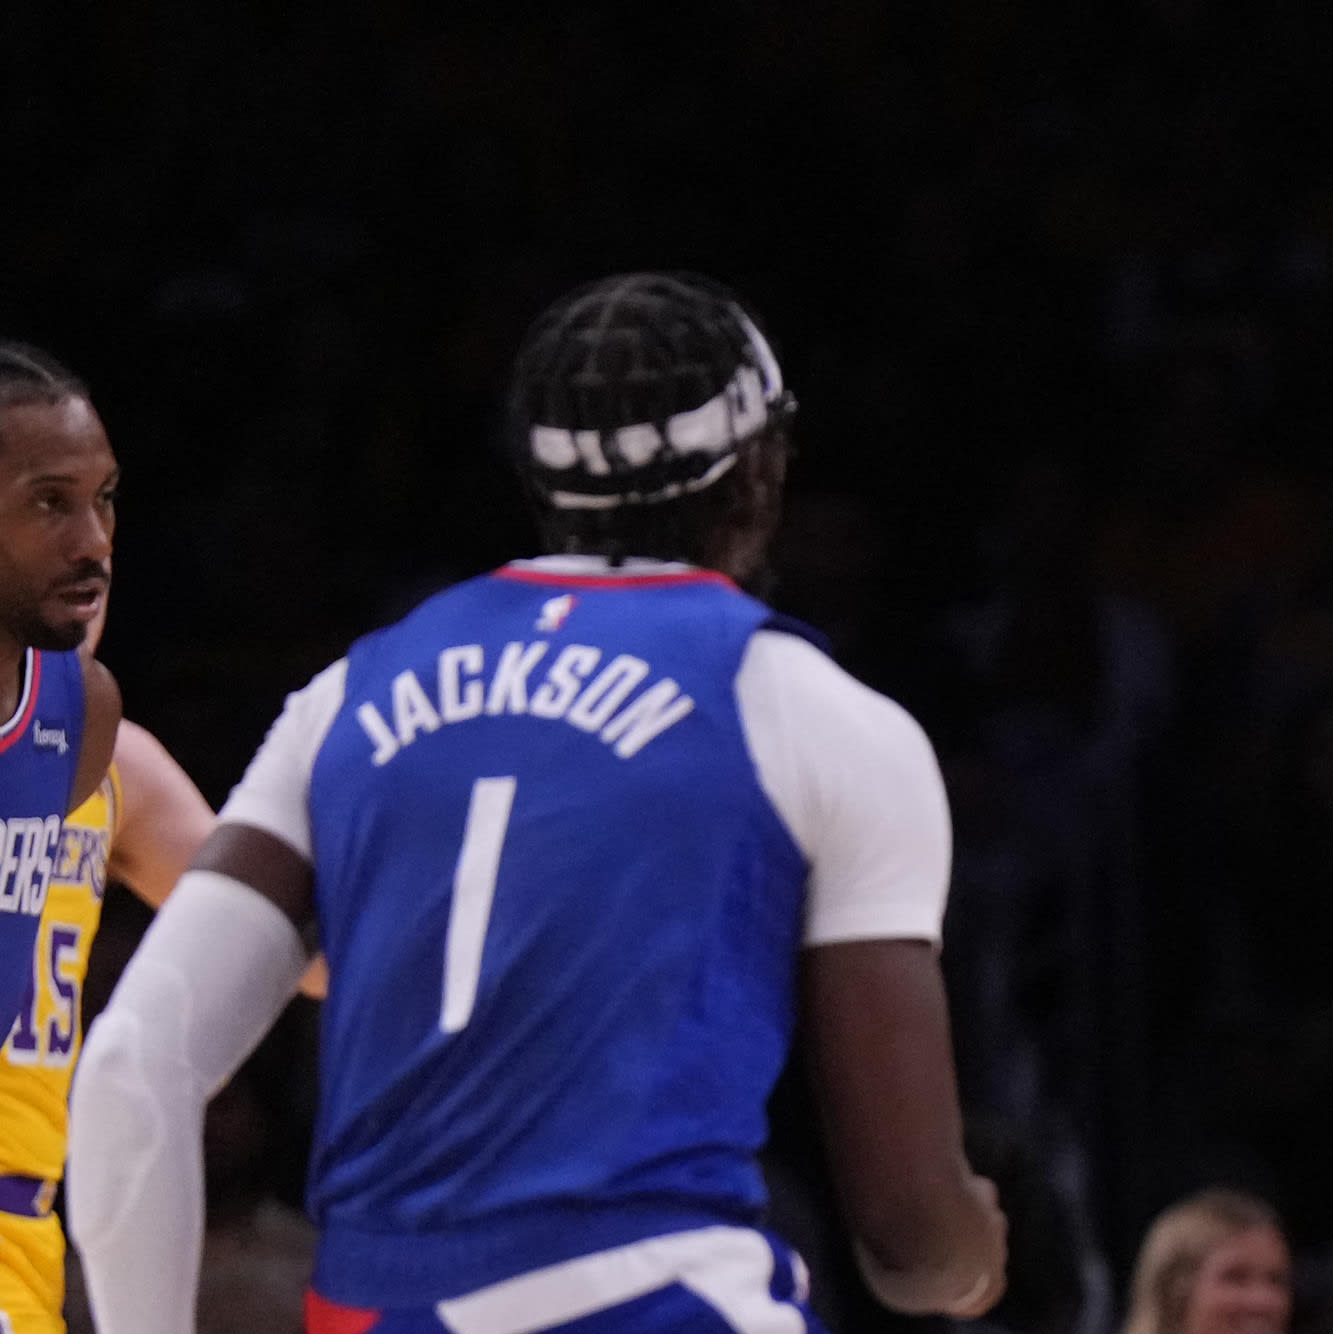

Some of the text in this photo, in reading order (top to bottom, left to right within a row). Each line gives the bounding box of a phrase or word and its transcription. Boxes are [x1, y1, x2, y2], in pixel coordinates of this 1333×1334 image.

[355, 639, 696, 768] JACKSON
[437, 775, 517, 1034] 1
[6, 921, 82, 1067] 15
